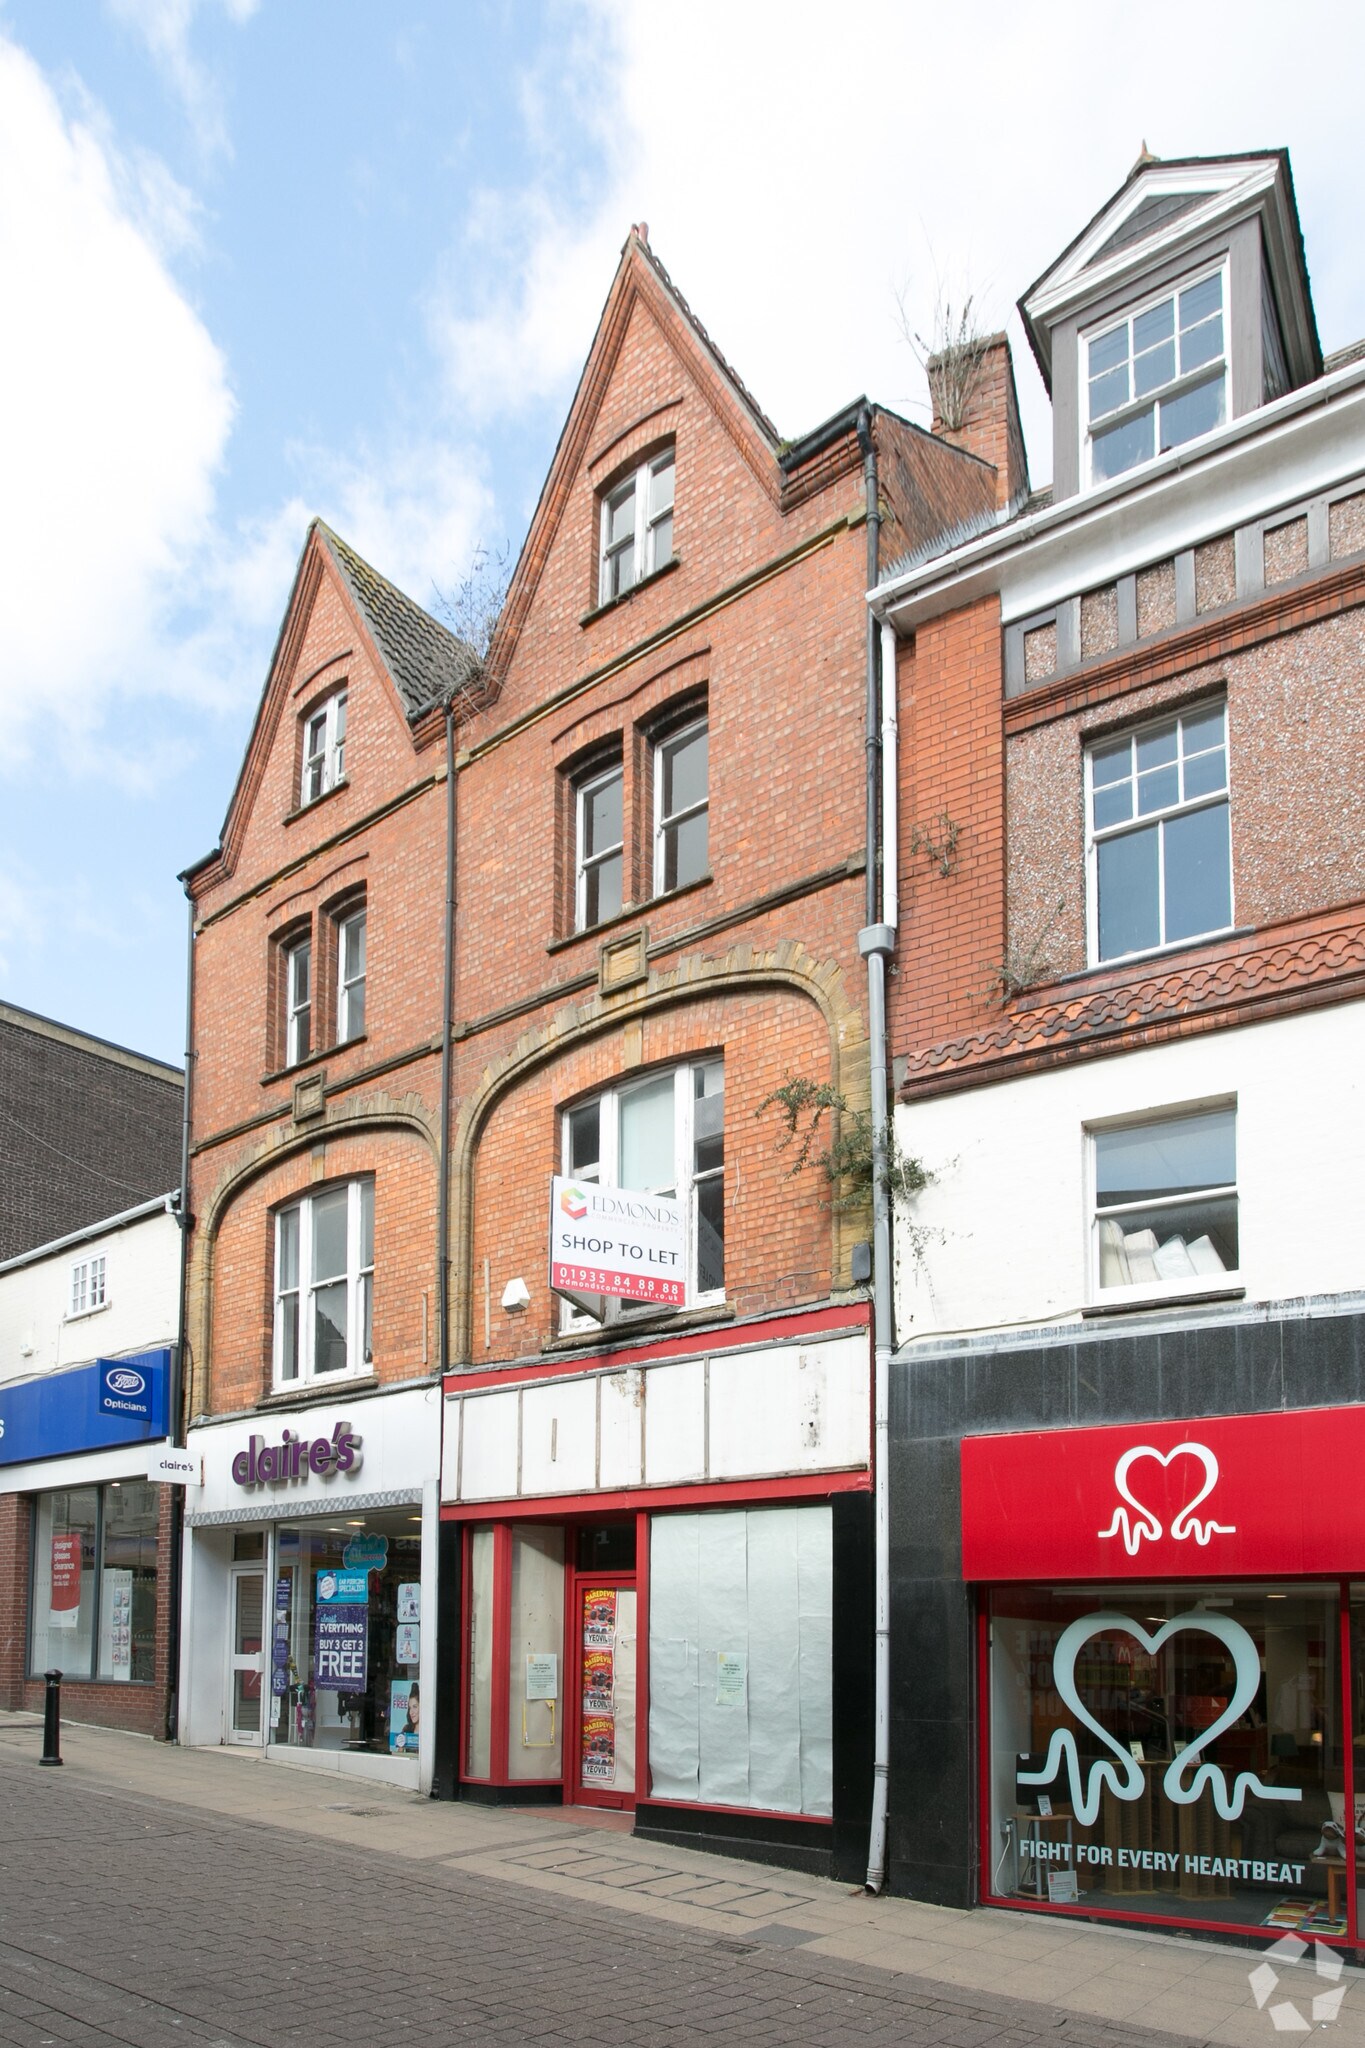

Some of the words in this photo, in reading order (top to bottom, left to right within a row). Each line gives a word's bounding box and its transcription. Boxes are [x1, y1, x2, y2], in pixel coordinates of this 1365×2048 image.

[592, 1196, 679, 1226] EDMONDS
[591, 1213, 640, 1227] COMMERCIAL
[643, 1222, 679, 1233] PROPERTY
[562, 1234, 613, 1254] SHOP
[618, 1243, 643, 1260] TO
[649, 1249, 679, 1266] LET
[560, 1267, 606, 1284] 01935
[614, 1275, 630, 1288] 84
[638, 1279, 655, 1291] 88
[662, 1283, 679, 1295] 88
[560, 1279, 679, 1301] edmondscommercial.co.uk
[112, 1373, 140, 1389] Boots
[104, 1398, 147, 1413] Opticians
[232, 1421, 361, 1486] claire's
[160, 1459, 194, 1472] claire's
[54, 1562, 75, 1570] clearance
[585, 1590, 615, 1602] DAREDEVIL
[320, 1623, 364, 1634] EVERYTHING
[589, 1634, 607, 1642] YEOVIL
[319, 1640, 334, 1650] BUY
[335, 1640, 340, 1650] 3
[342, 1640, 357, 1651] GET
[358, 1641, 364, 1651] 3
[319, 1651, 363, 1678] FREE
[584, 1655, 612, 1668] DAREDEVIL
[393, 1700, 408, 1709] FREE
[589, 1700, 607, 1708] YEOVIL
[583, 1721, 614, 1732] DAREDEVIL
[586, 1765, 607, 1775] YEOVIL
[1020, 1840, 1073, 1862] FIGHT
[1077, 1845, 1113, 1866] FOR
[1118, 1848, 1180, 1872] EVERY
[1184, 1854, 1306, 1885] HEARTBEAT
